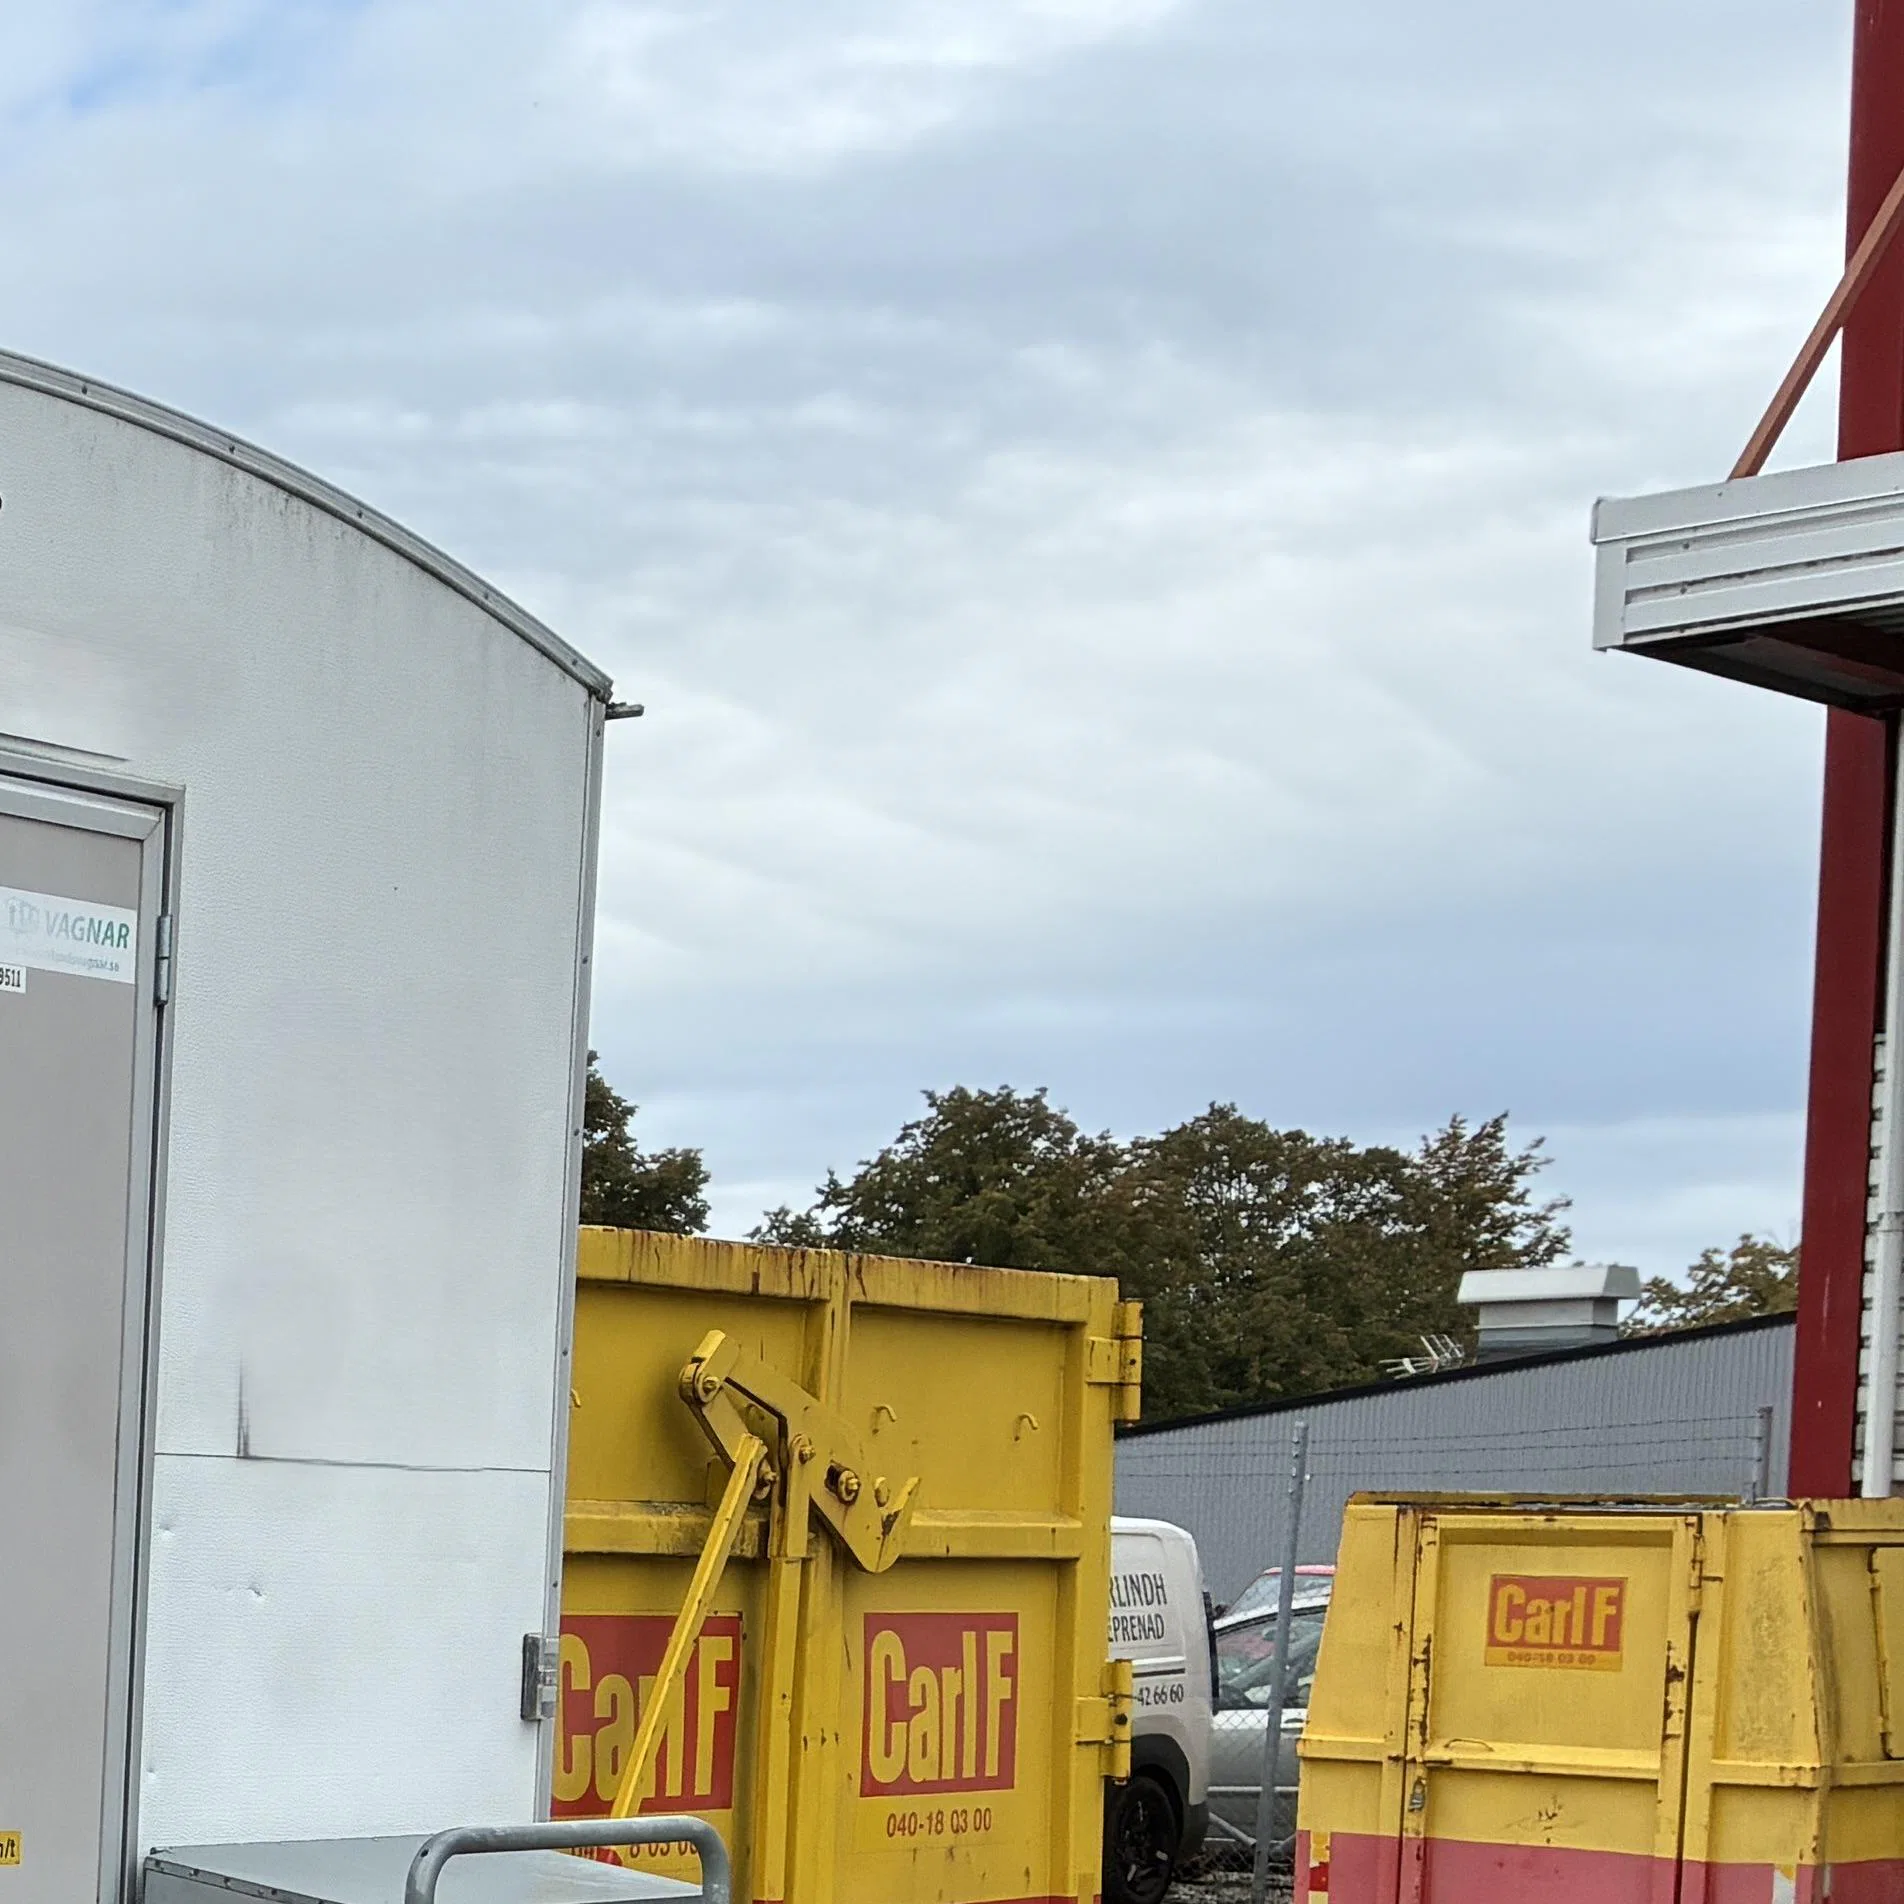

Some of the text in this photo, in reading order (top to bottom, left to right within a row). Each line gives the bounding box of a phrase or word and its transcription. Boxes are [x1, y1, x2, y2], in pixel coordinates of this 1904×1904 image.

[44, 908, 130, 949] VAGNAR
[1108, 1613, 1165, 1643] PRENAD
[887, 1807, 992, 1838] 040-18 03 00
